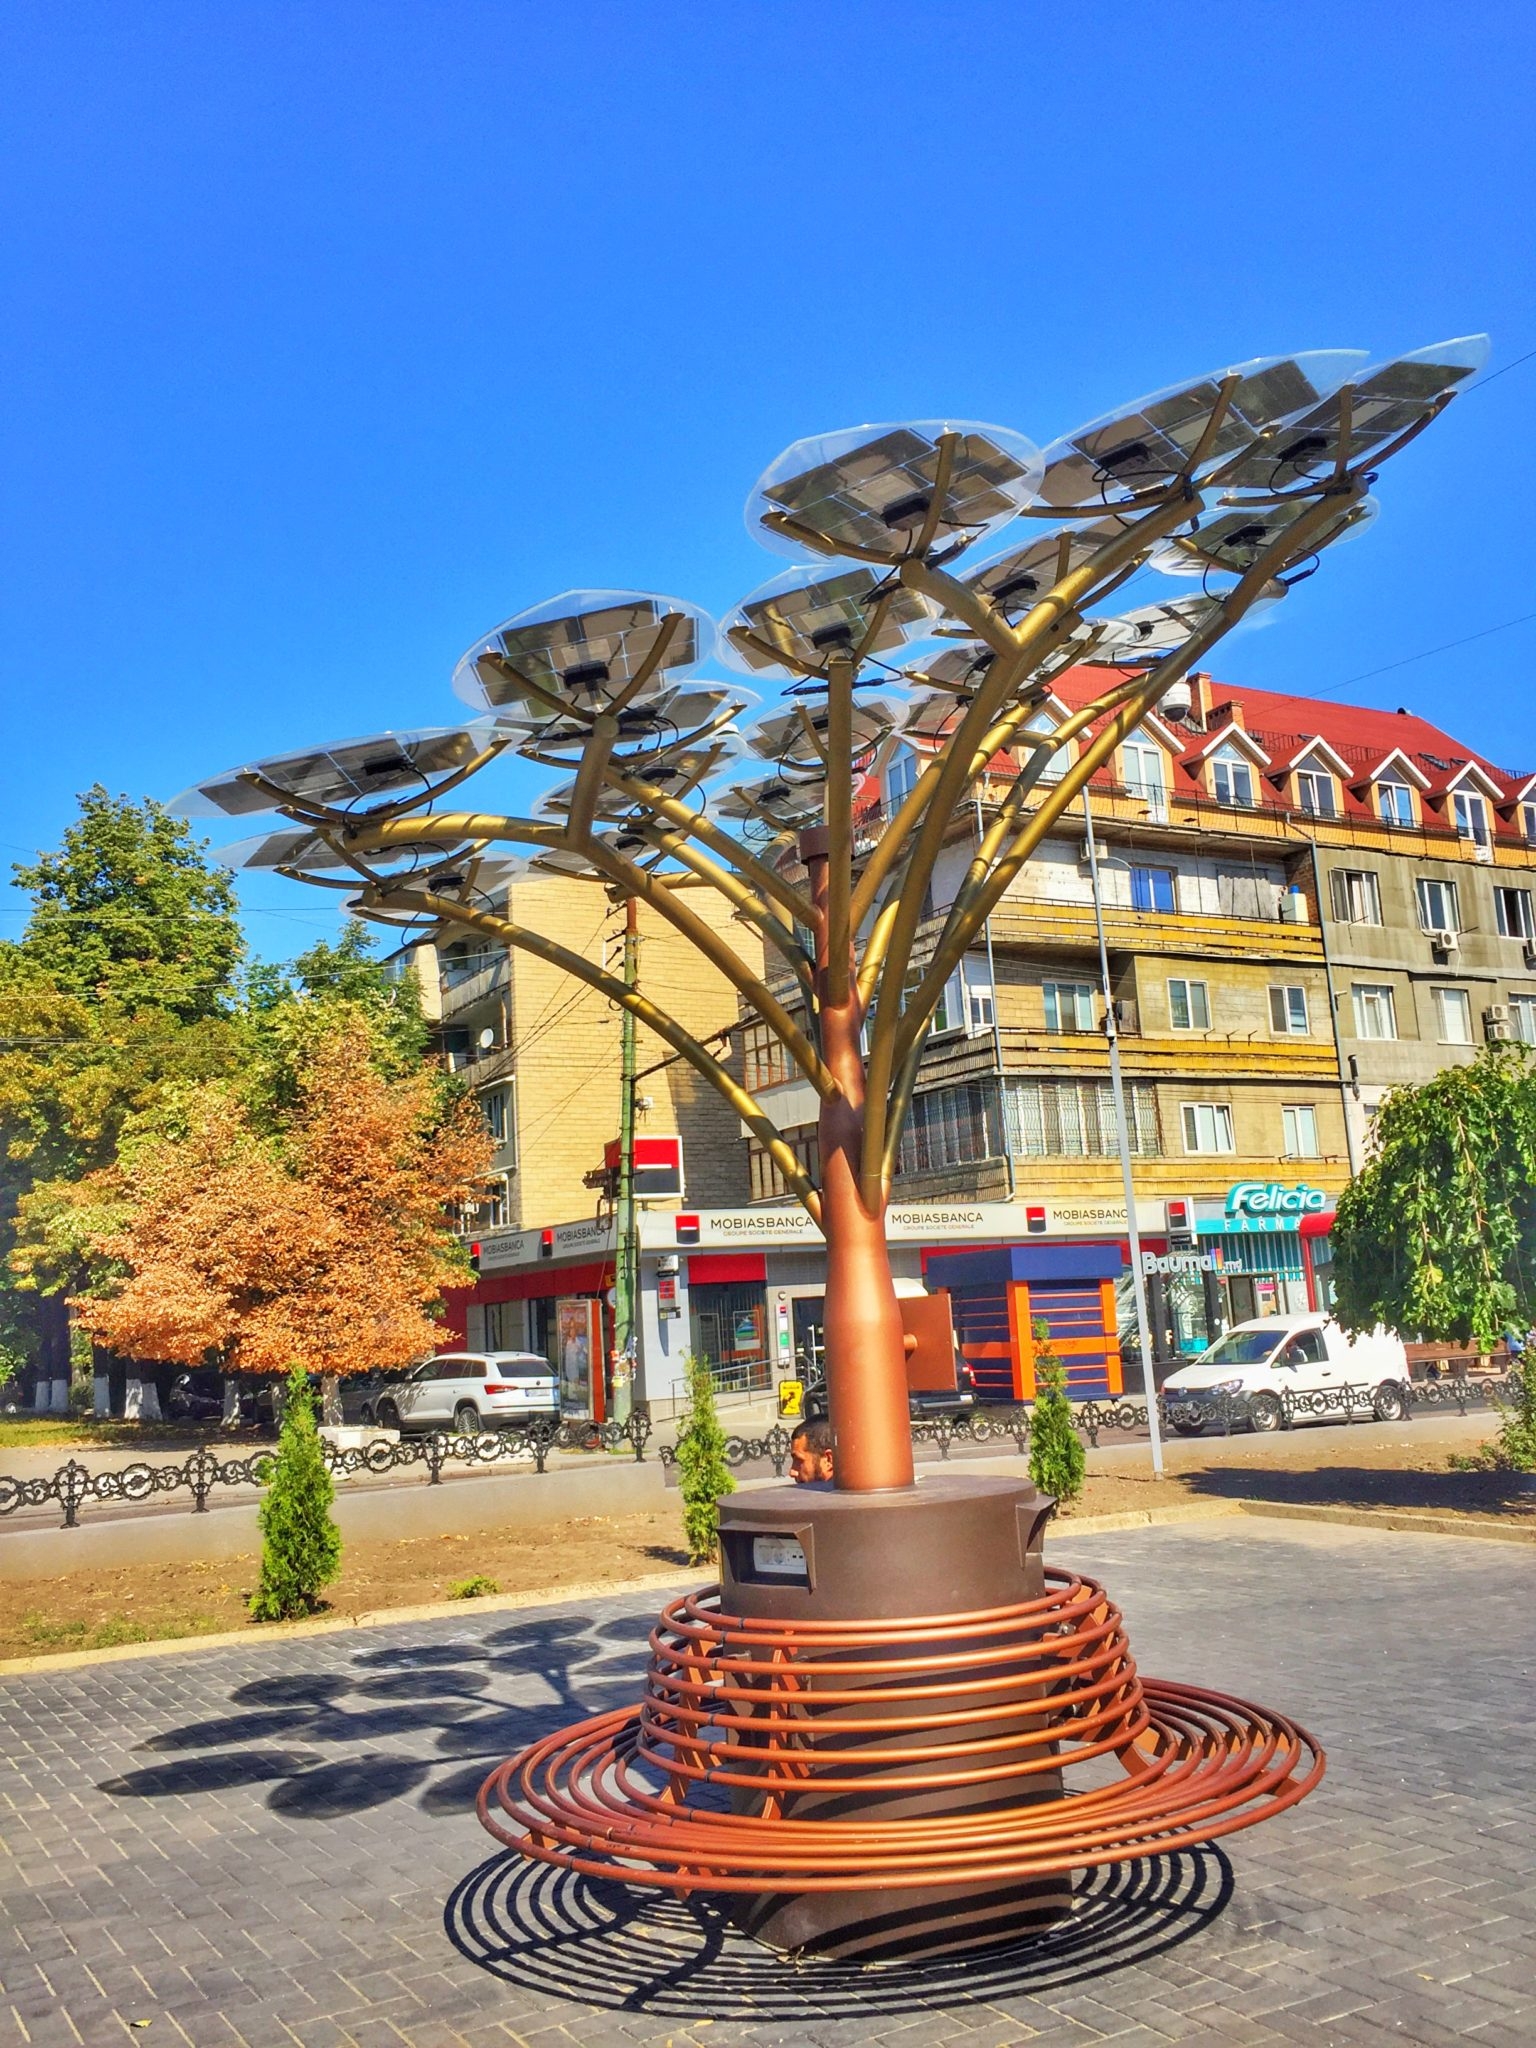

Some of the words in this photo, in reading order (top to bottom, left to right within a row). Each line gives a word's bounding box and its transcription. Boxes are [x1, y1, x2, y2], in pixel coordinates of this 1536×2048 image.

[1230, 1183, 1327, 1211] Felicia
[891, 1212, 984, 1224] MOBIASBANCA
[1053, 1209, 1128, 1220] MOBIASBANC
[710, 1216, 814, 1230] MOBIASBANCA
[556, 1224, 606, 1243] MOBIASBANCA
[483, 1239, 525, 1255] MOBIASBANCA
